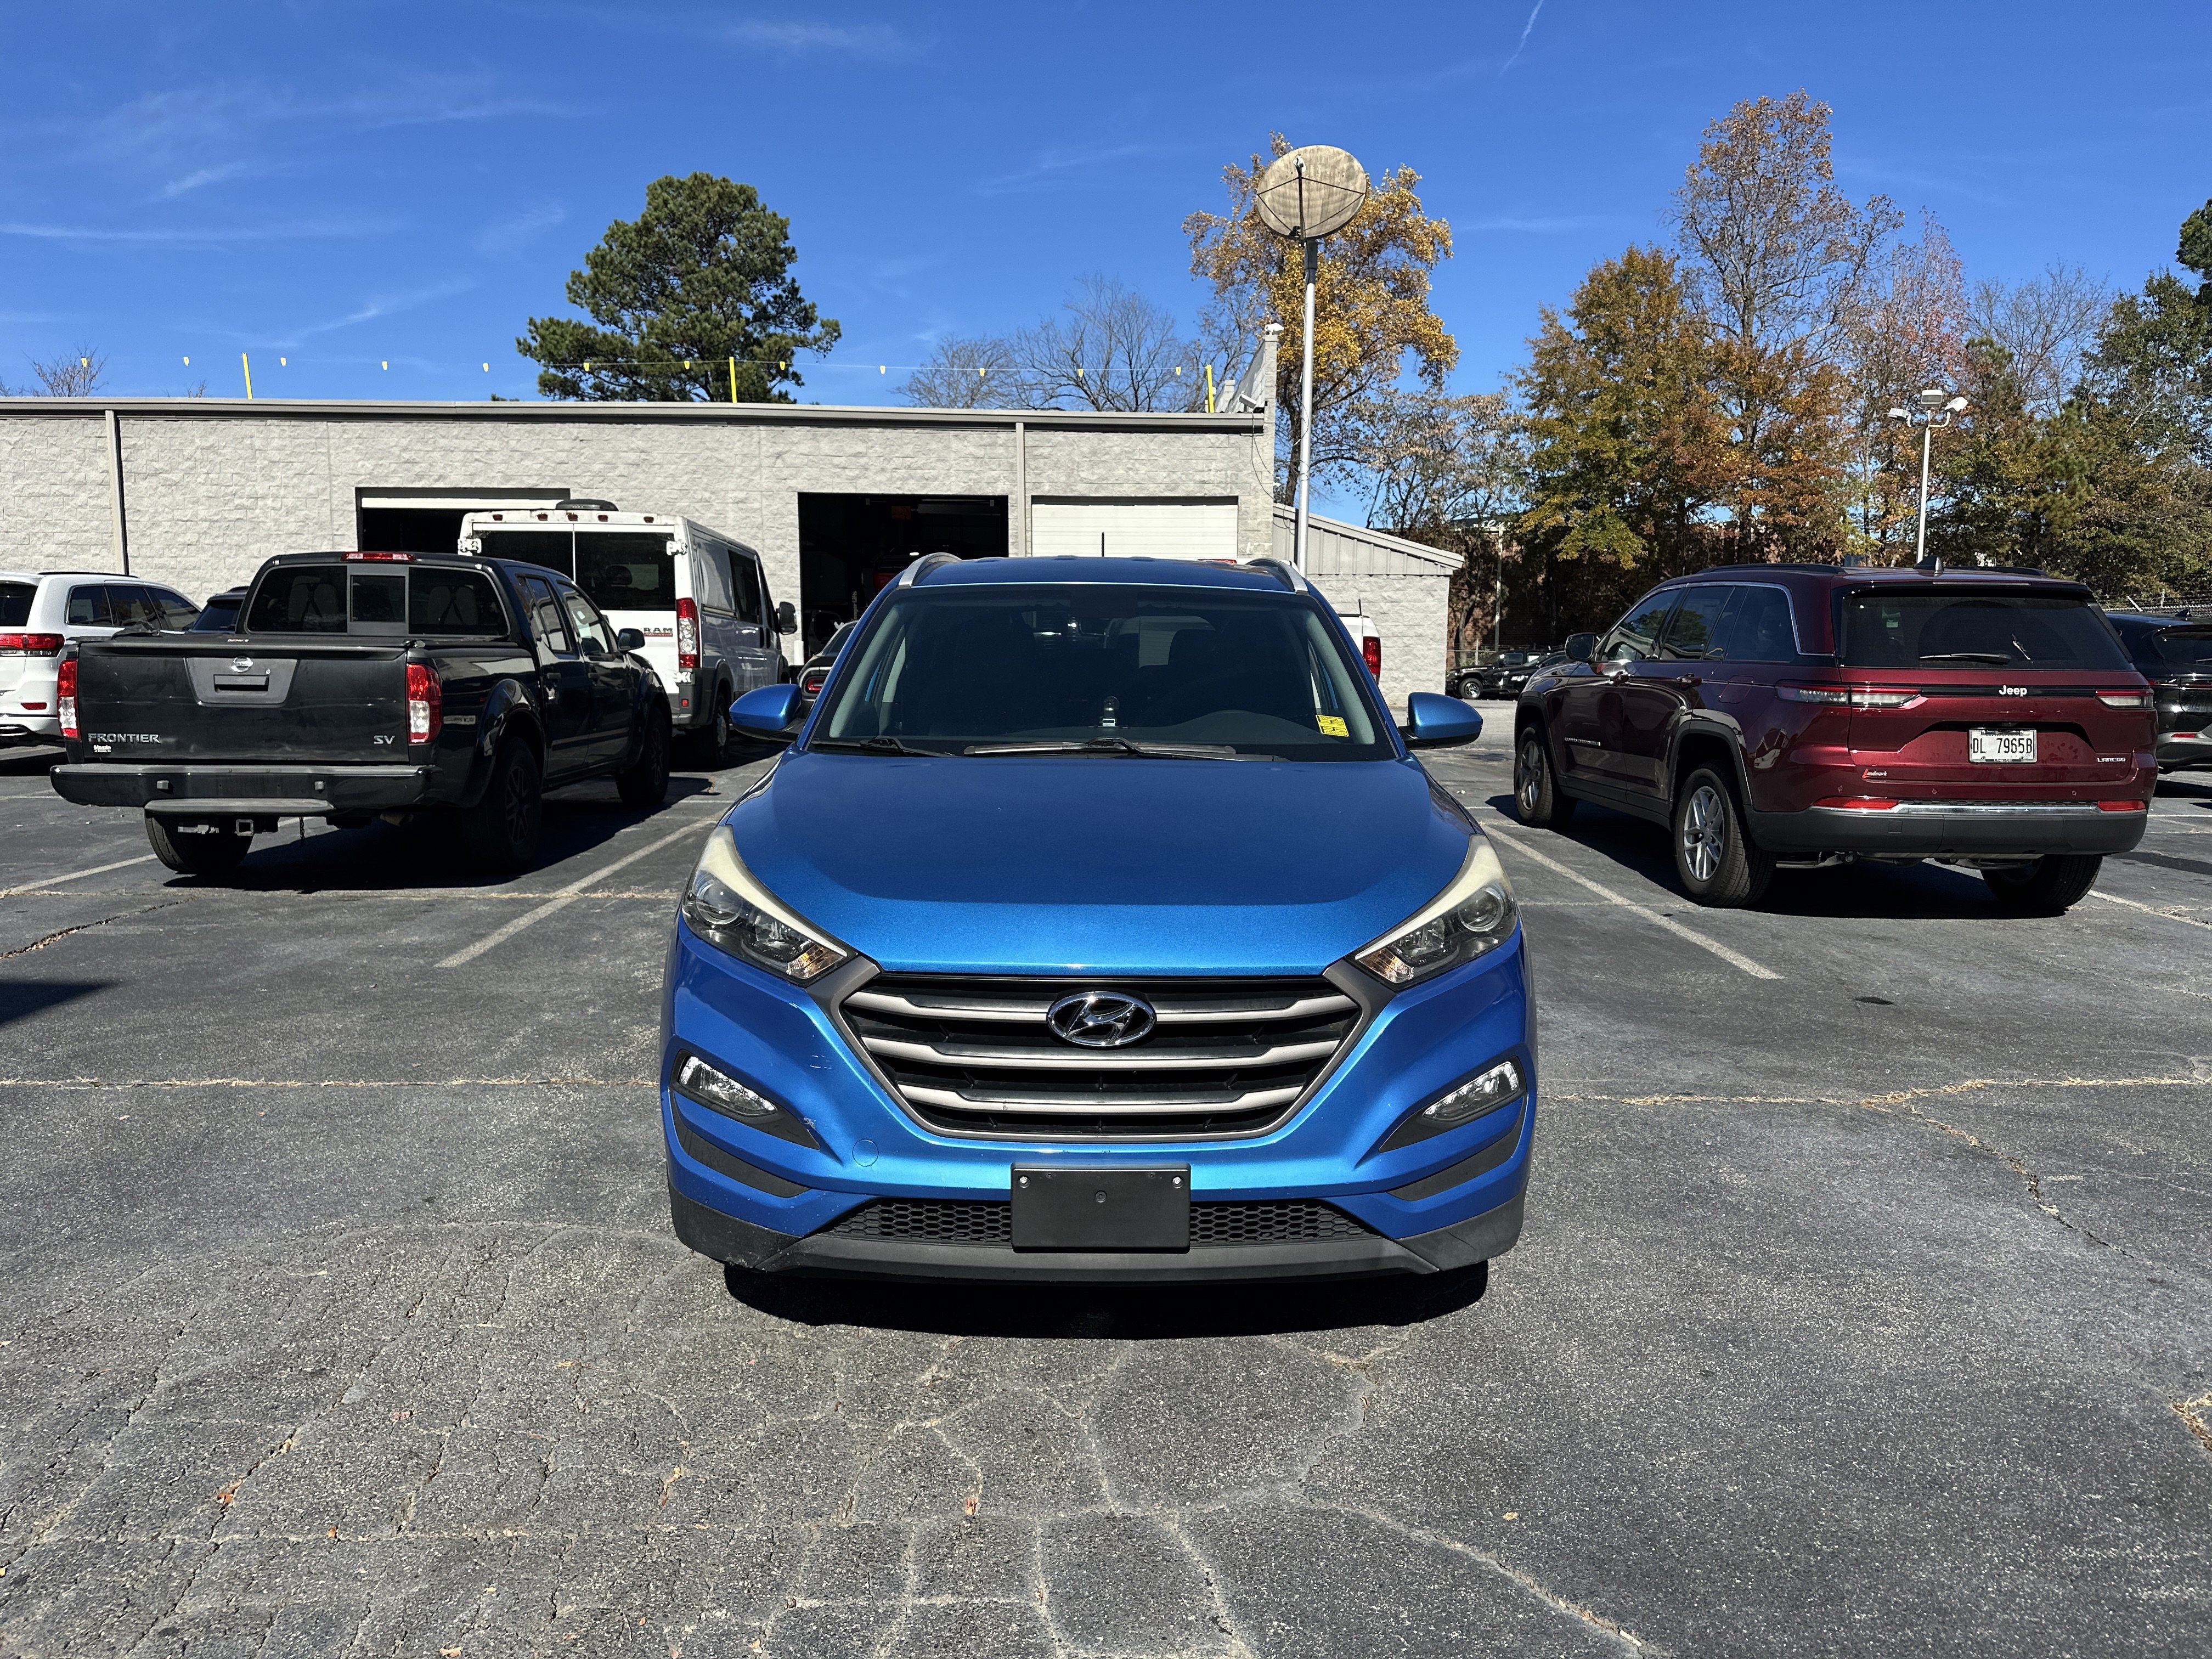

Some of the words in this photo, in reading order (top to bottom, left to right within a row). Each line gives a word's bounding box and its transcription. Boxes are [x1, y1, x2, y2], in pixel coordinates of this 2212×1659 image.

[1999, 685, 2028, 697] Jeep
[88, 733, 162, 744] FRONTIER
[374, 735, 395, 744] SV
[1972, 737, 1986, 753] DL
[1996, 737, 2033, 753] 7965B
